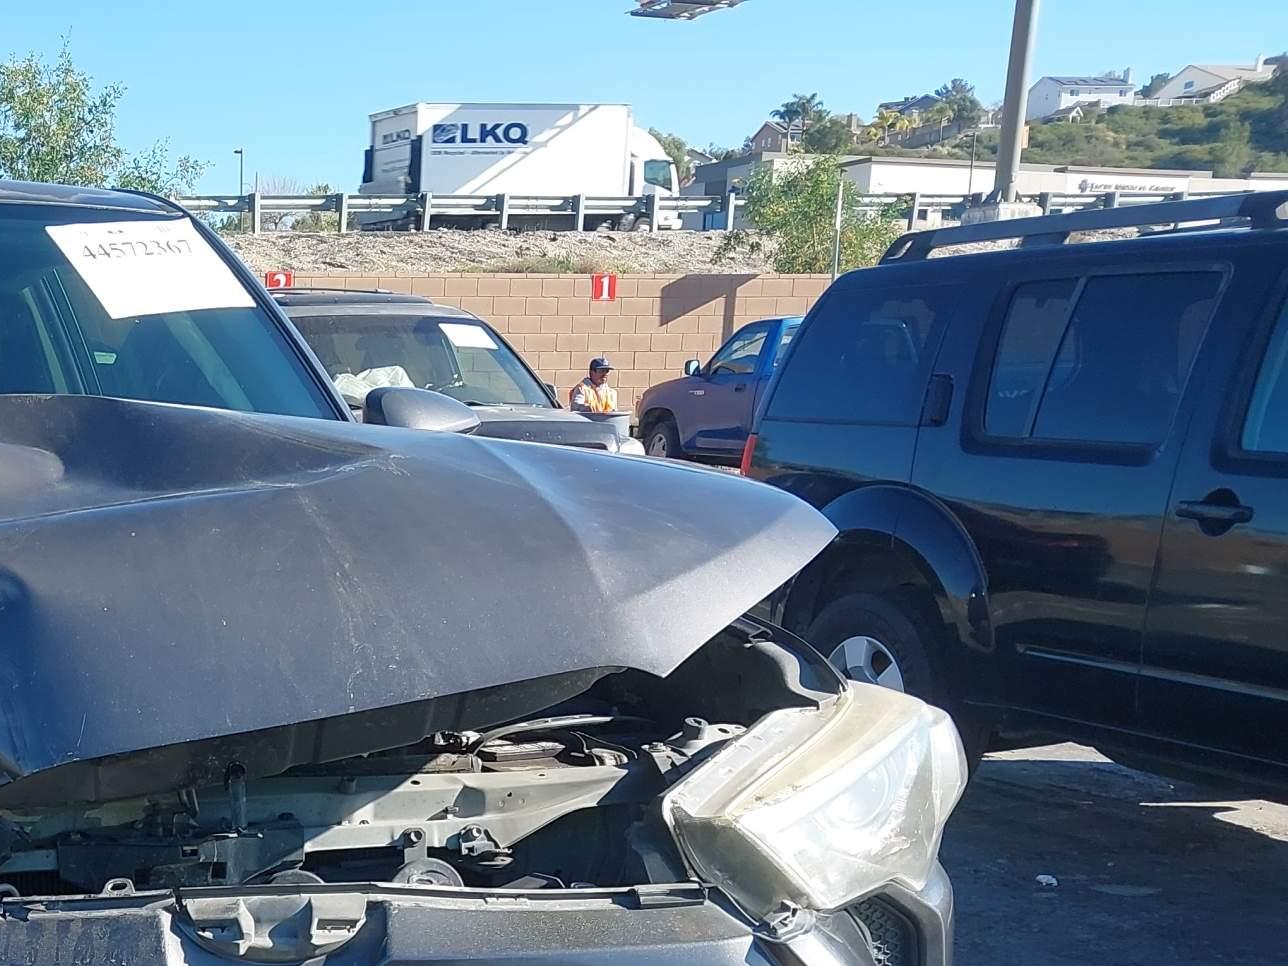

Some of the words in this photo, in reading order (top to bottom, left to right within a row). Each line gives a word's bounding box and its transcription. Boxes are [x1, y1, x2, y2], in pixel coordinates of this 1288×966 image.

[460, 122, 528, 145] LKQ
[82, 239, 192, 260] 44572367
[600, 275, 611, 299] 1
